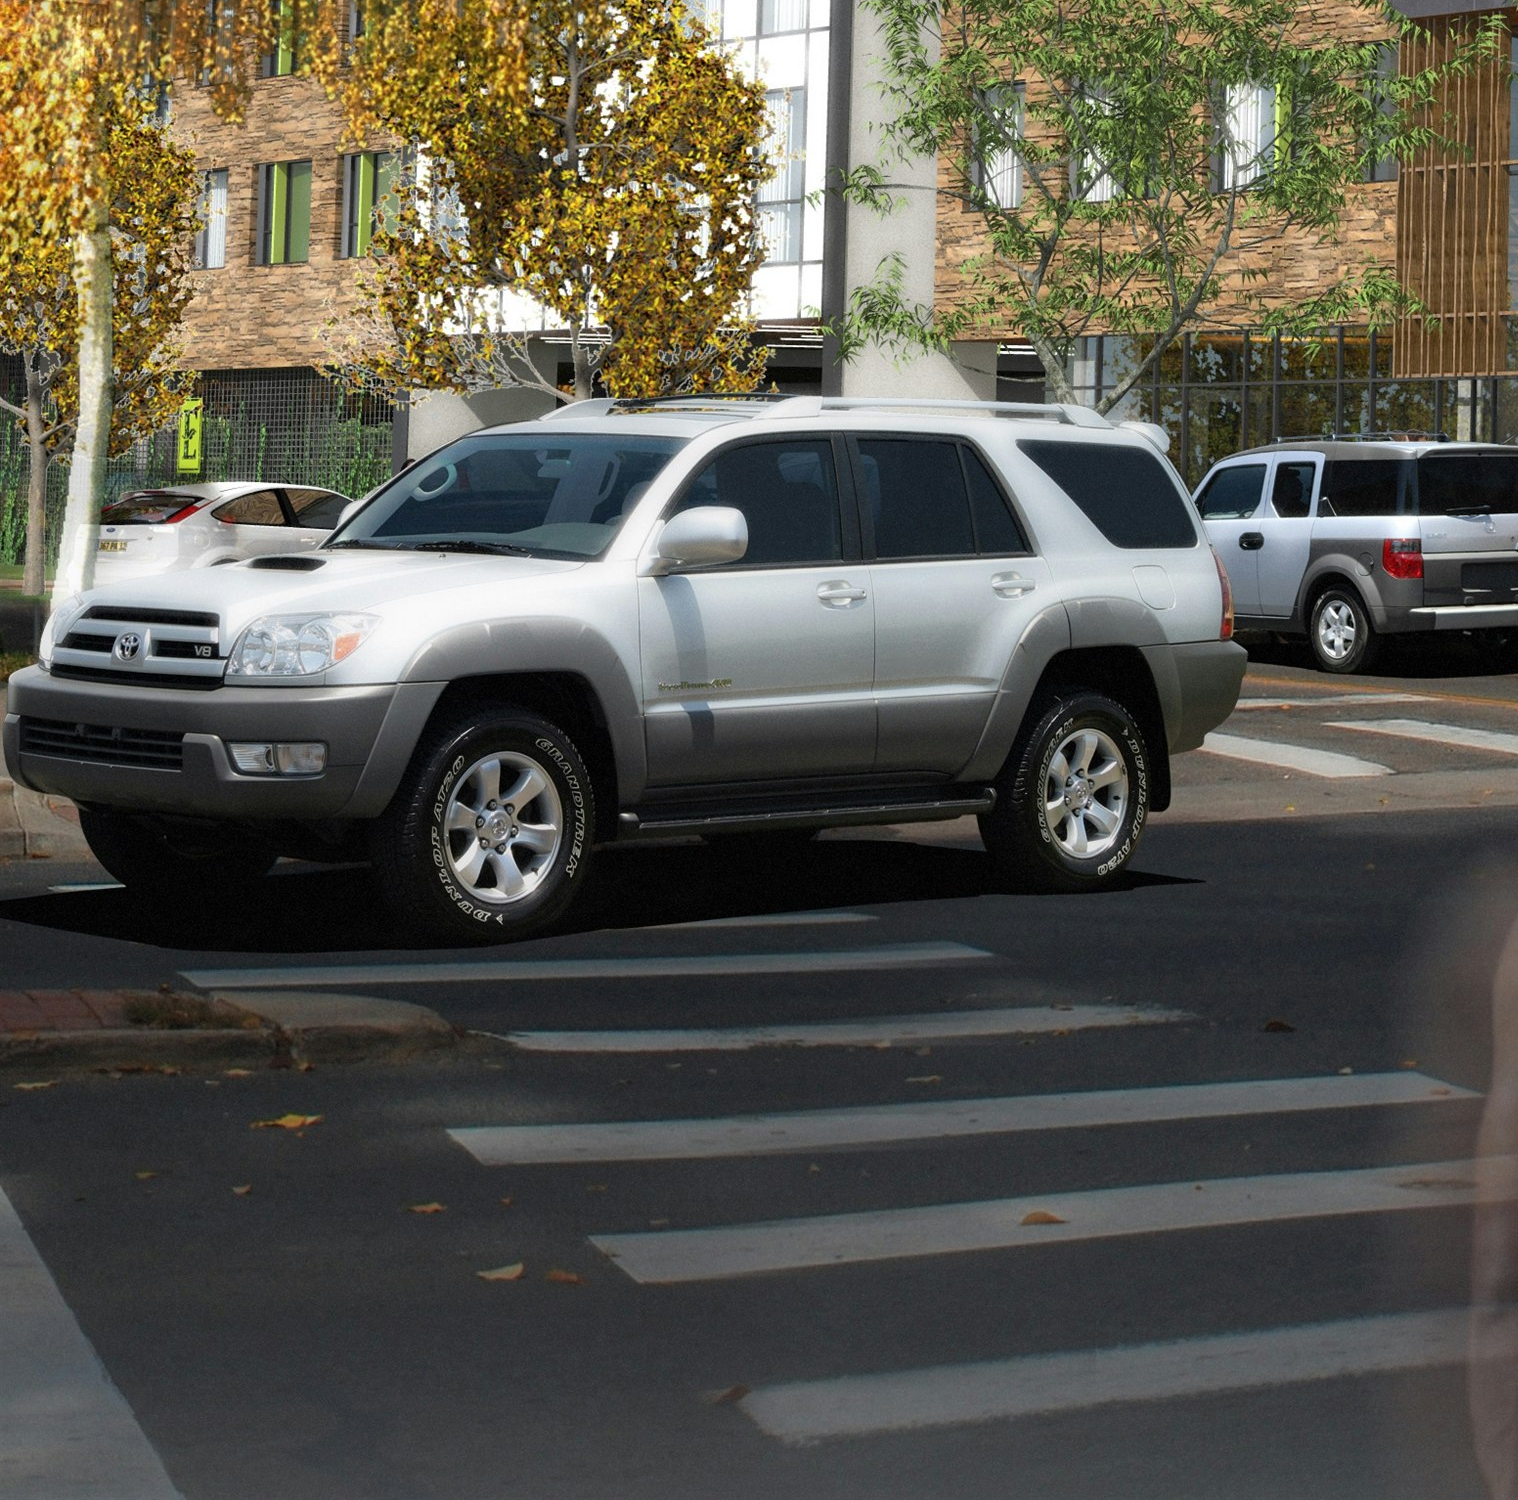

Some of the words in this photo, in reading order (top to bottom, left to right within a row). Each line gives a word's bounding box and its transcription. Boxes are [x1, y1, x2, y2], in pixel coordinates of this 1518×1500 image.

[194, 644, 212, 657] V8
[433, 755, 465, 822] AT20
[535, 738, 586, 878] GRANDTREK
[1127, 738, 1147, 840] DUNLOP
[431, 826, 492, 922] DUNLOP
[1097, 838, 1131, 876] AT20
